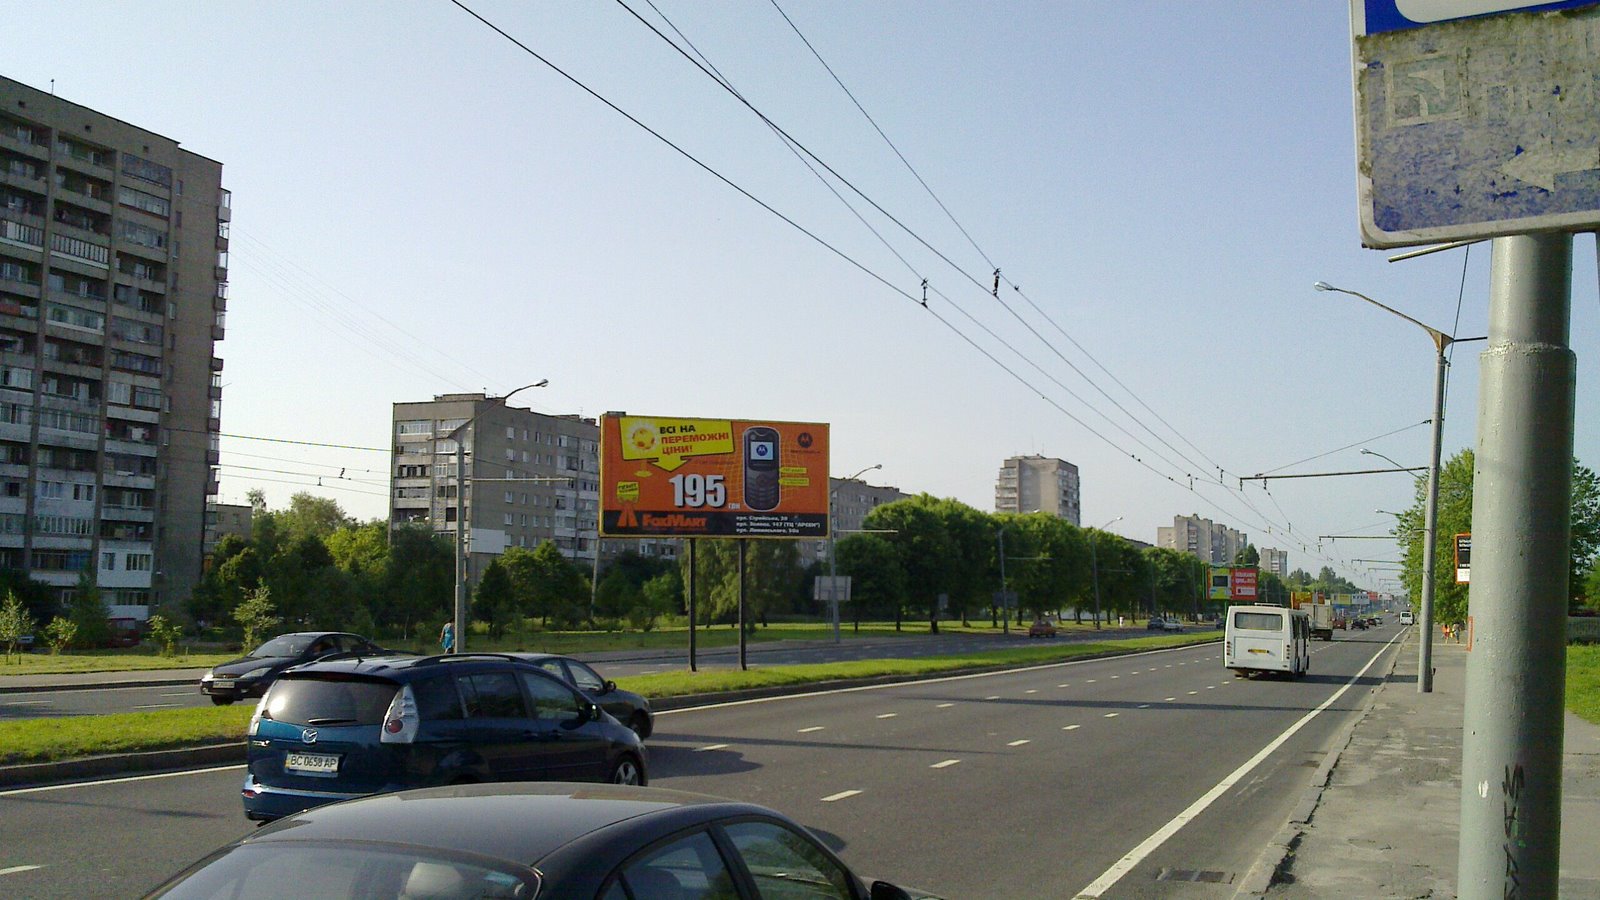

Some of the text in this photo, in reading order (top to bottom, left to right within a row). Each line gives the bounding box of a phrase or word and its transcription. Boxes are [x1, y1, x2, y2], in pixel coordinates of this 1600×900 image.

[660, 425, 696, 434] ВСІ НА
[661, 432, 729, 444] ПЕРЕМОЖНІ
[662, 445, 693, 455] ЦІНИ!
[669, 474, 725, 507] 195
